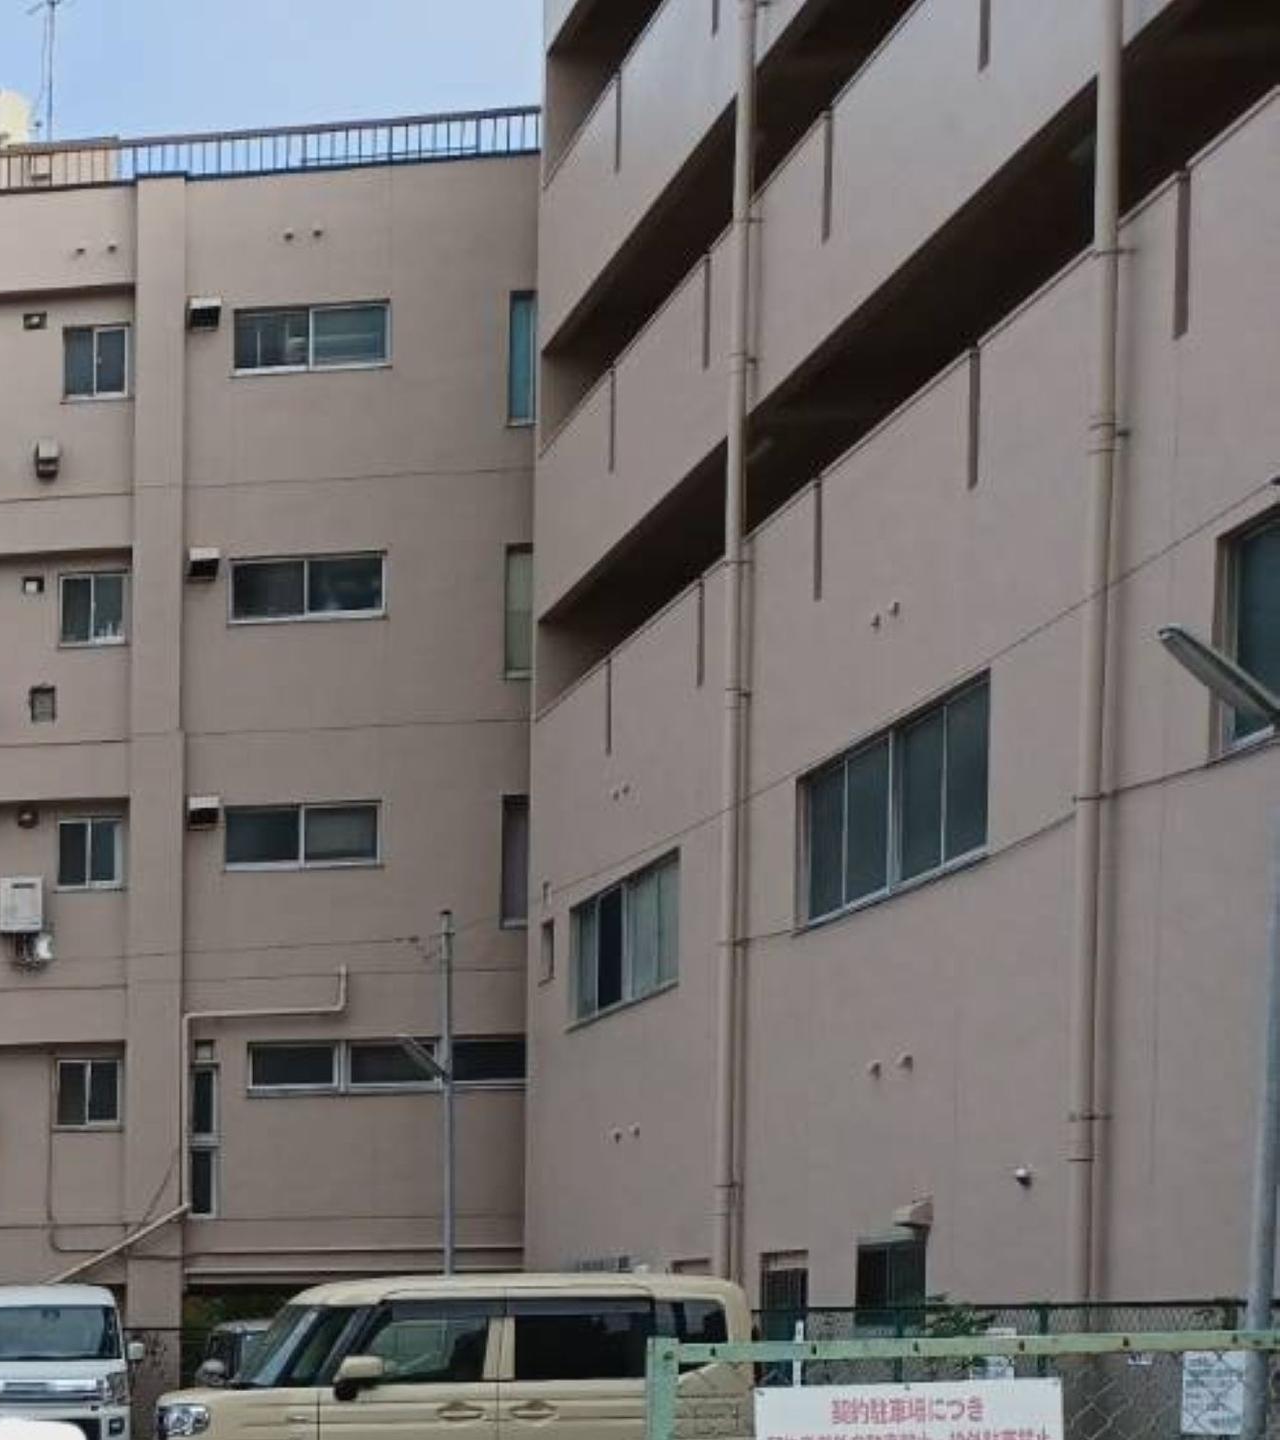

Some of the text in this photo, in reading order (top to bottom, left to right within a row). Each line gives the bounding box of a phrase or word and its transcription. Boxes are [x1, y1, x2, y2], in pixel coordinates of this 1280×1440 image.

[831, 1395, 987, 1425] 契約駐車場につき
